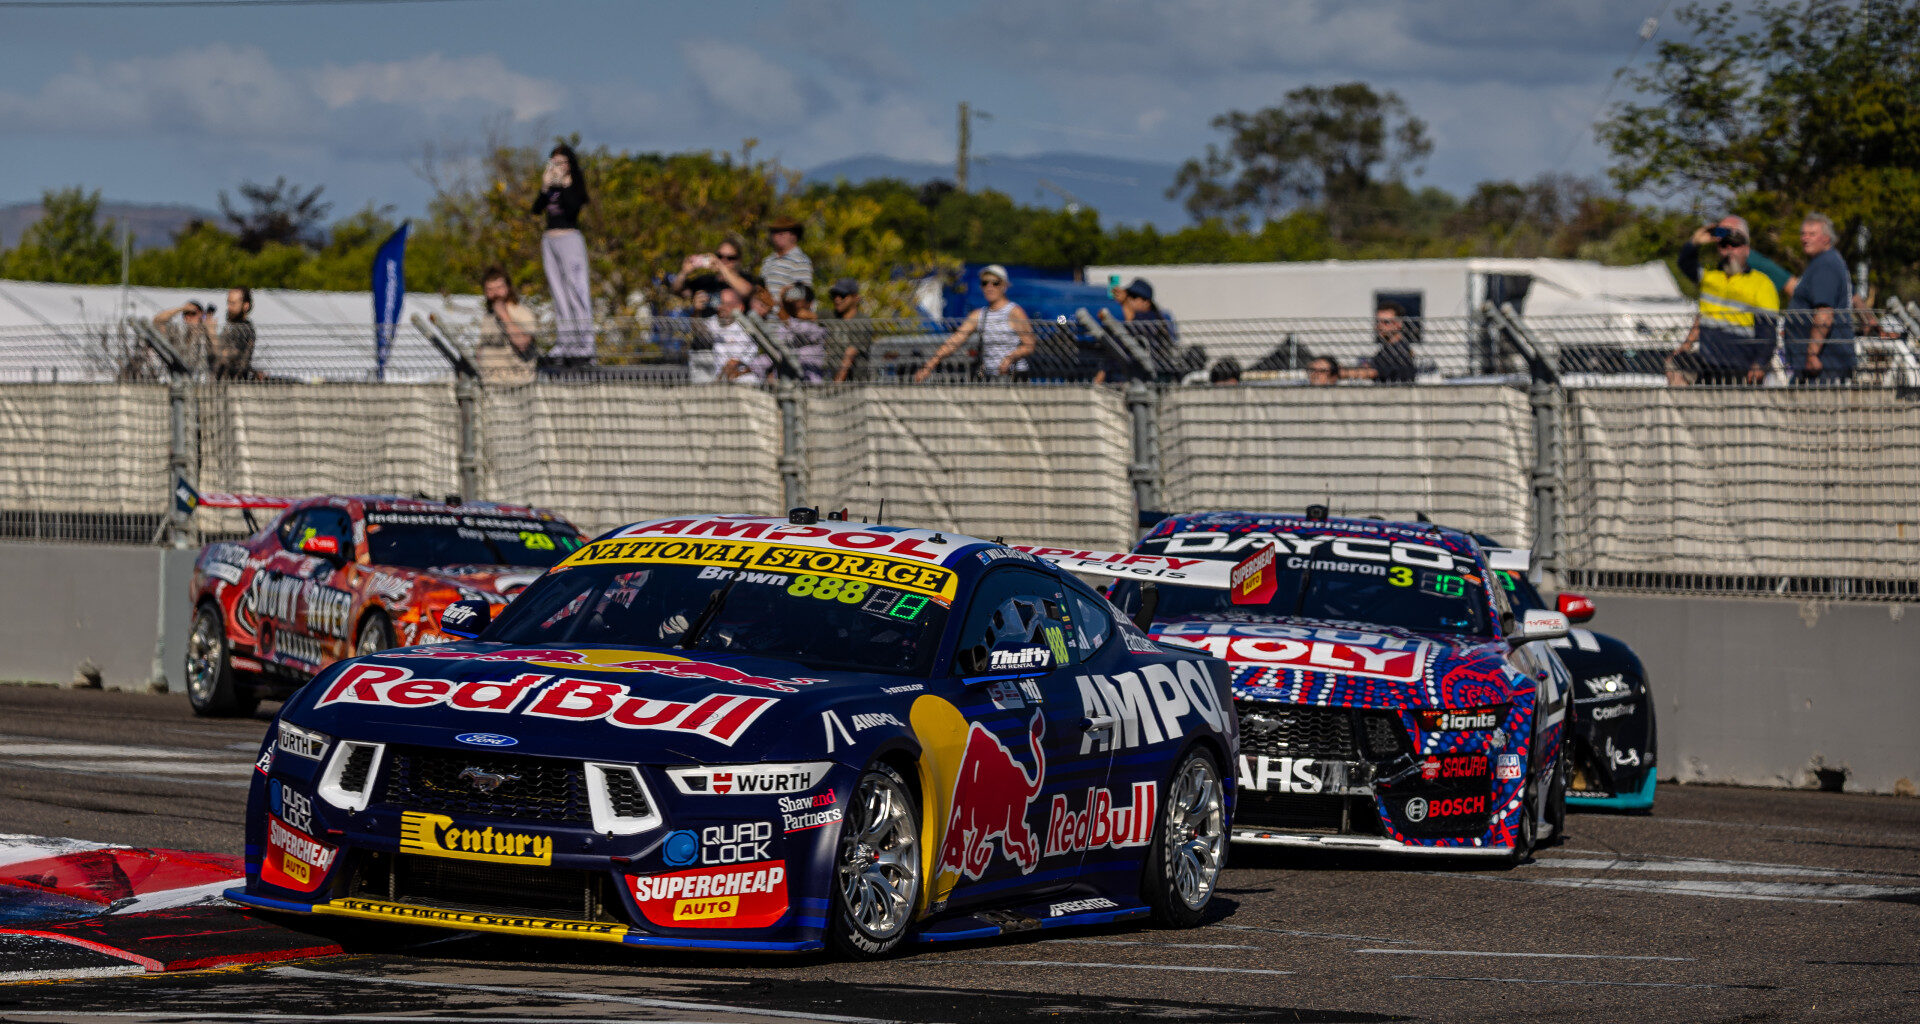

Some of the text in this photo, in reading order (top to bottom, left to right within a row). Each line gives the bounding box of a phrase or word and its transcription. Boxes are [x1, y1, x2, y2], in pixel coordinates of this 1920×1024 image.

[519, 531, 555, 550] 20
[624, 519, 943, 560] AMPOL
[1163, 531, 1454, 570] DAYCO
[578, 540, 944, 589] NATIONAL STORAGE
[697, 565, 788, 587] Brown
[1077, 559, 1188, 579] Fuels
[1232, 545, 1275, 589] SUPERCHEAP
[1287, 557, 1386, 576] Cameron
[1244, 575, 1260, 591] AUTO
[1388, 566, 1413, 587] 3
[787, 574, 869, 604] 888
[991, 647, 1050, 667] Thrifty
[1158, 636, 1412, 673] MOLY
[889, 684, 924, 694] DUNLOP
[314, 663, 781, 747] Red Bull
[1075, 660, 1231, 755] AMPOL
[851, 712, 906, 731] AMPOL
[1450, 713, 1497, 730] ignite
[1442, 755, 1488, 778] SAKURA
[737, 771, 812, 792] WÜRTH
[282, 784, 312, 816] QUAD
[1428, 796, 1485, 818] BOSCH
[283, 803, 314, 835] LOCK
[782, 807, 843, 832] Partners
[1044, 786, 1096, 857] Red
[1089, 781, 1158, 849] Bull
[427, 813, 552, 860] Century
[702, 821, 773, 845] QUAD
[270, 819, 337, 872] SUPERCHEAP
[701, 841, 772, 864] LOCK
[285, 858, 307, 878] AUTO
[636, 866, 784, 902] SUPERCHEAP
[680, 900, 731, 916] AUTO
